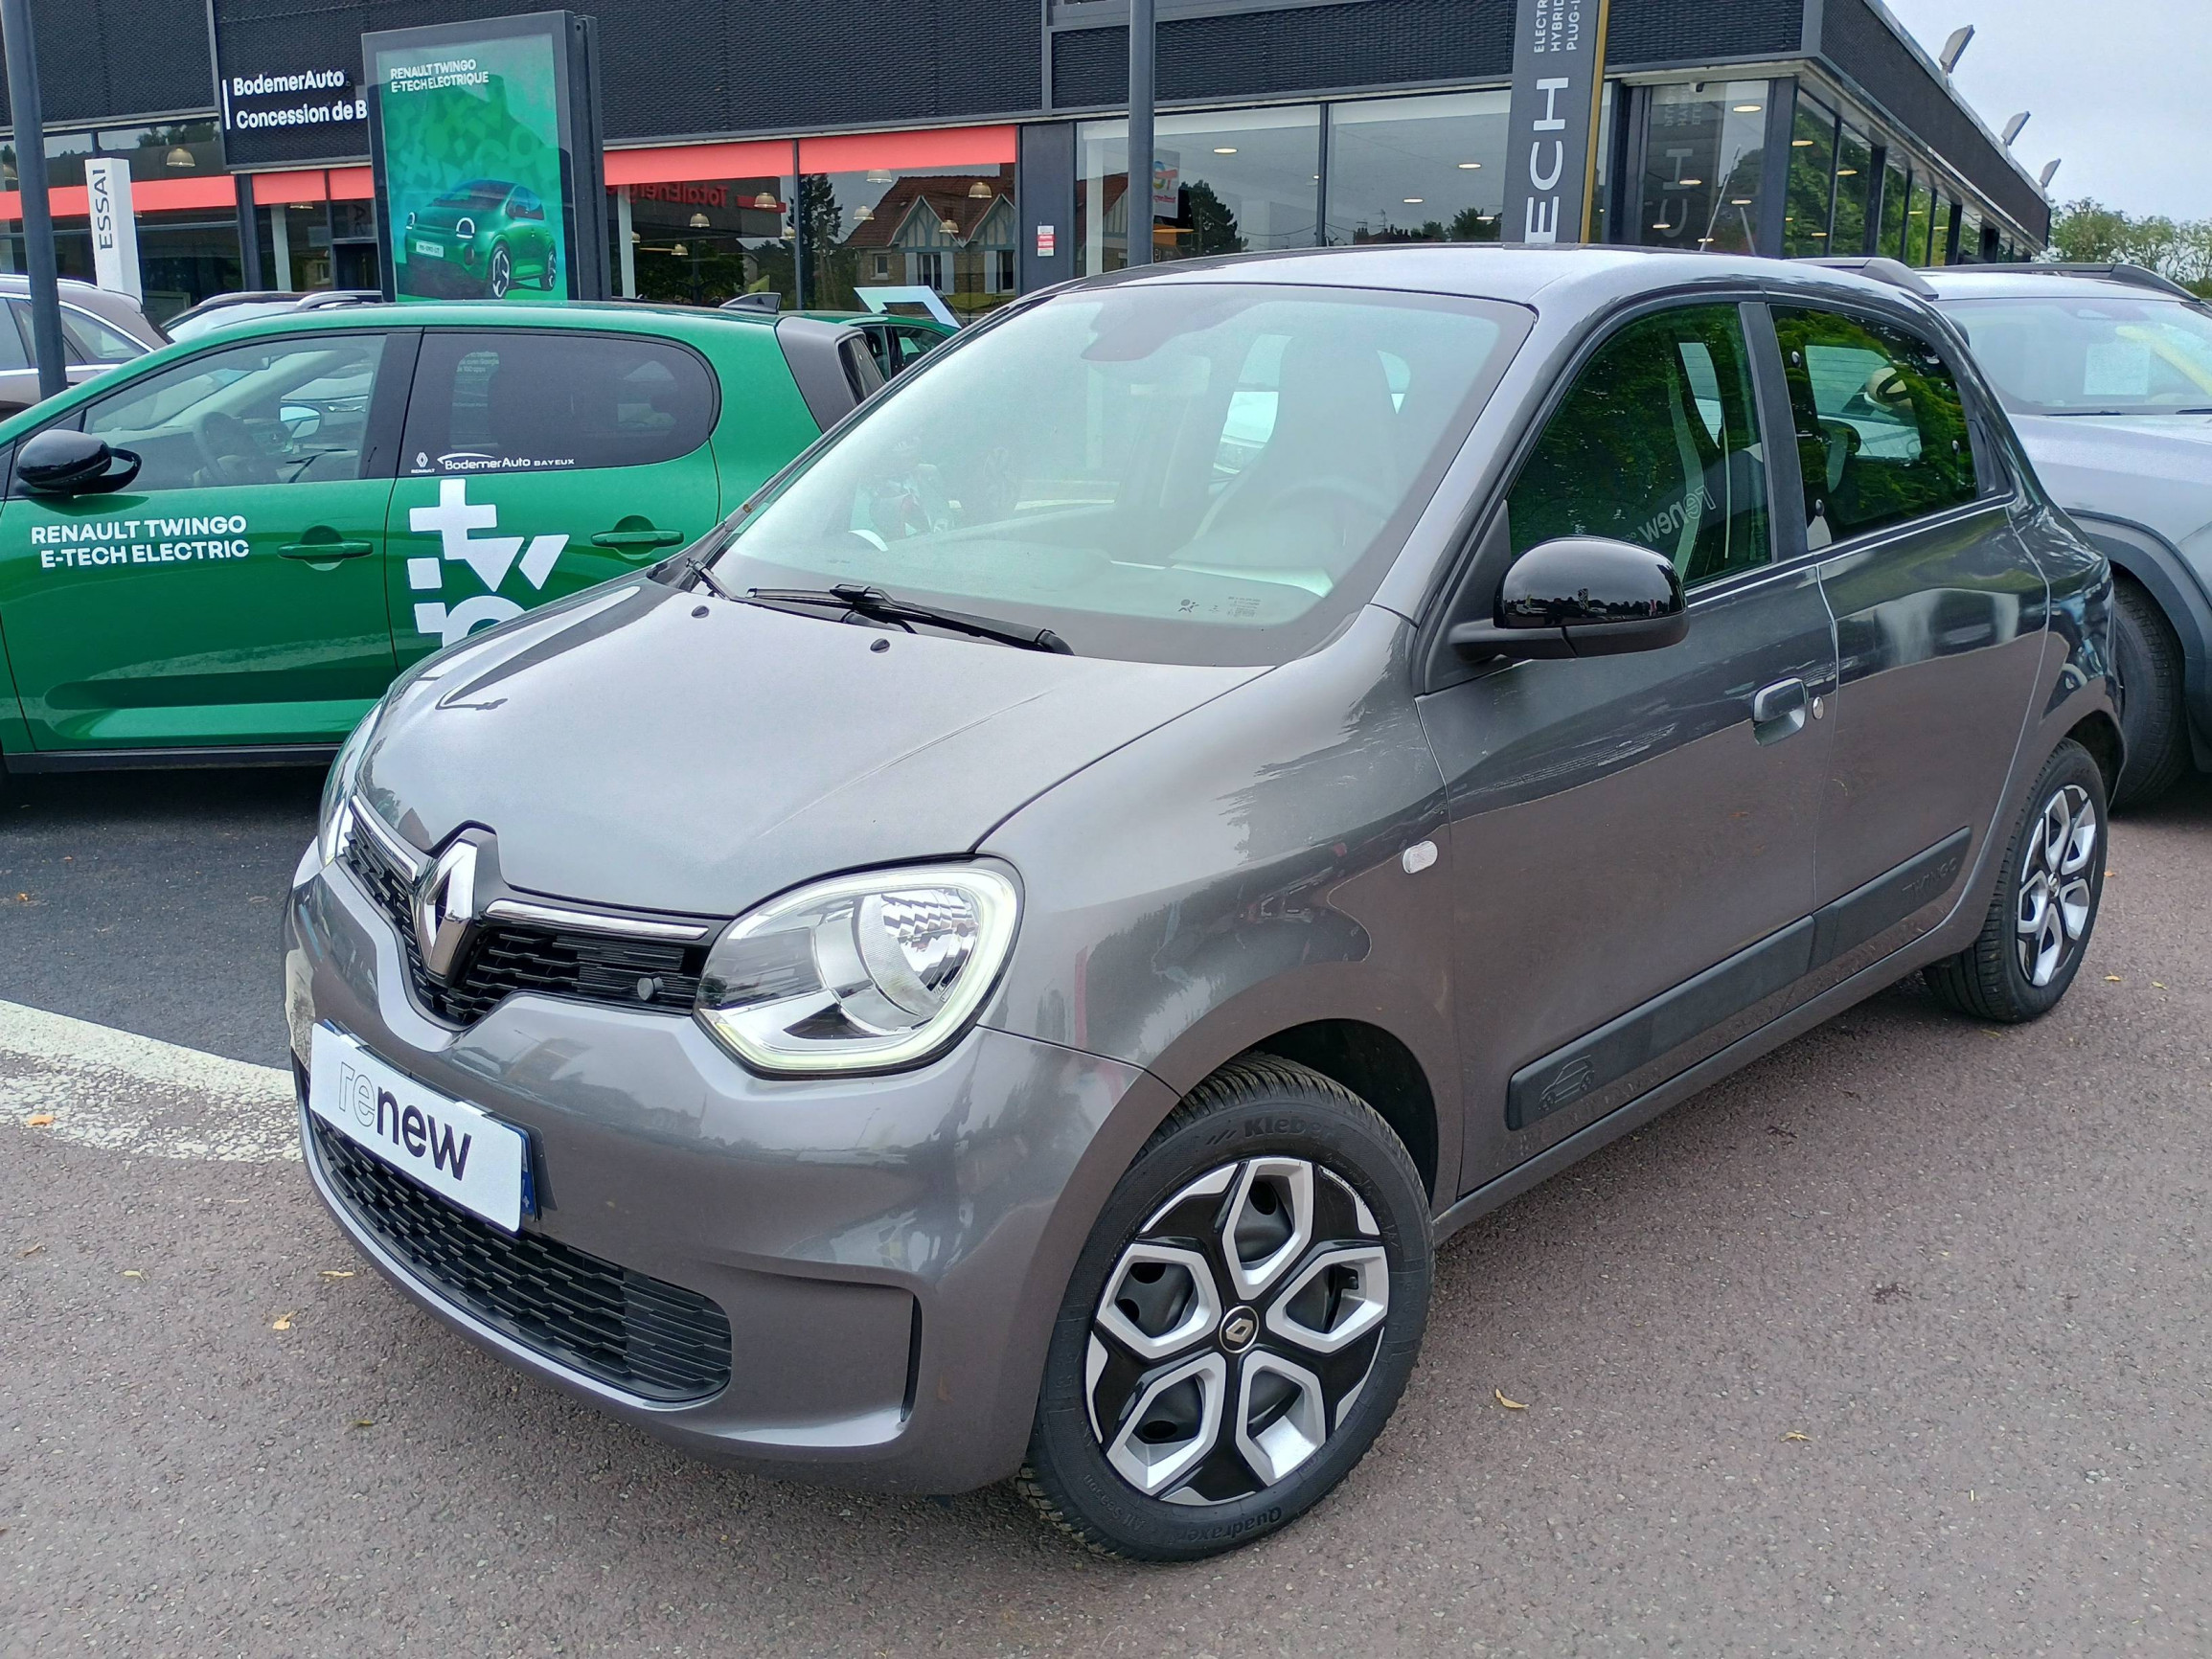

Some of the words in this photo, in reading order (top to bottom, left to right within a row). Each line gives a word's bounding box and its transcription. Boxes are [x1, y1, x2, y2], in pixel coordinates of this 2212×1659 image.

[233, 69, 345, 97] BodemerAuto
[390, 63, 433, 80] RENAULT
[434, 58, 477, 75] TWINGO
[391, 80, 428, 93] E-TECH
[428, 71, 490, 89] ELECTRIQUE
[236, 102, 330, 129] Concession
[331, 100, 353, 122] de
[355, 99, 368, 120] B
[92, 169, 113, 251] ESSAI
[445, 457, 531, 470] BodemerAuto
[31, 520, 141, 544] RENAULT
[144, 514, 247, 538] TWINGO
[40, 546, 127, 568] E-TECH
[131, 539, 250, 563] ELECTRIC
[338, 1060, 472, 1181] renew
[1245, 1116, 1336, 1140] Kleber
